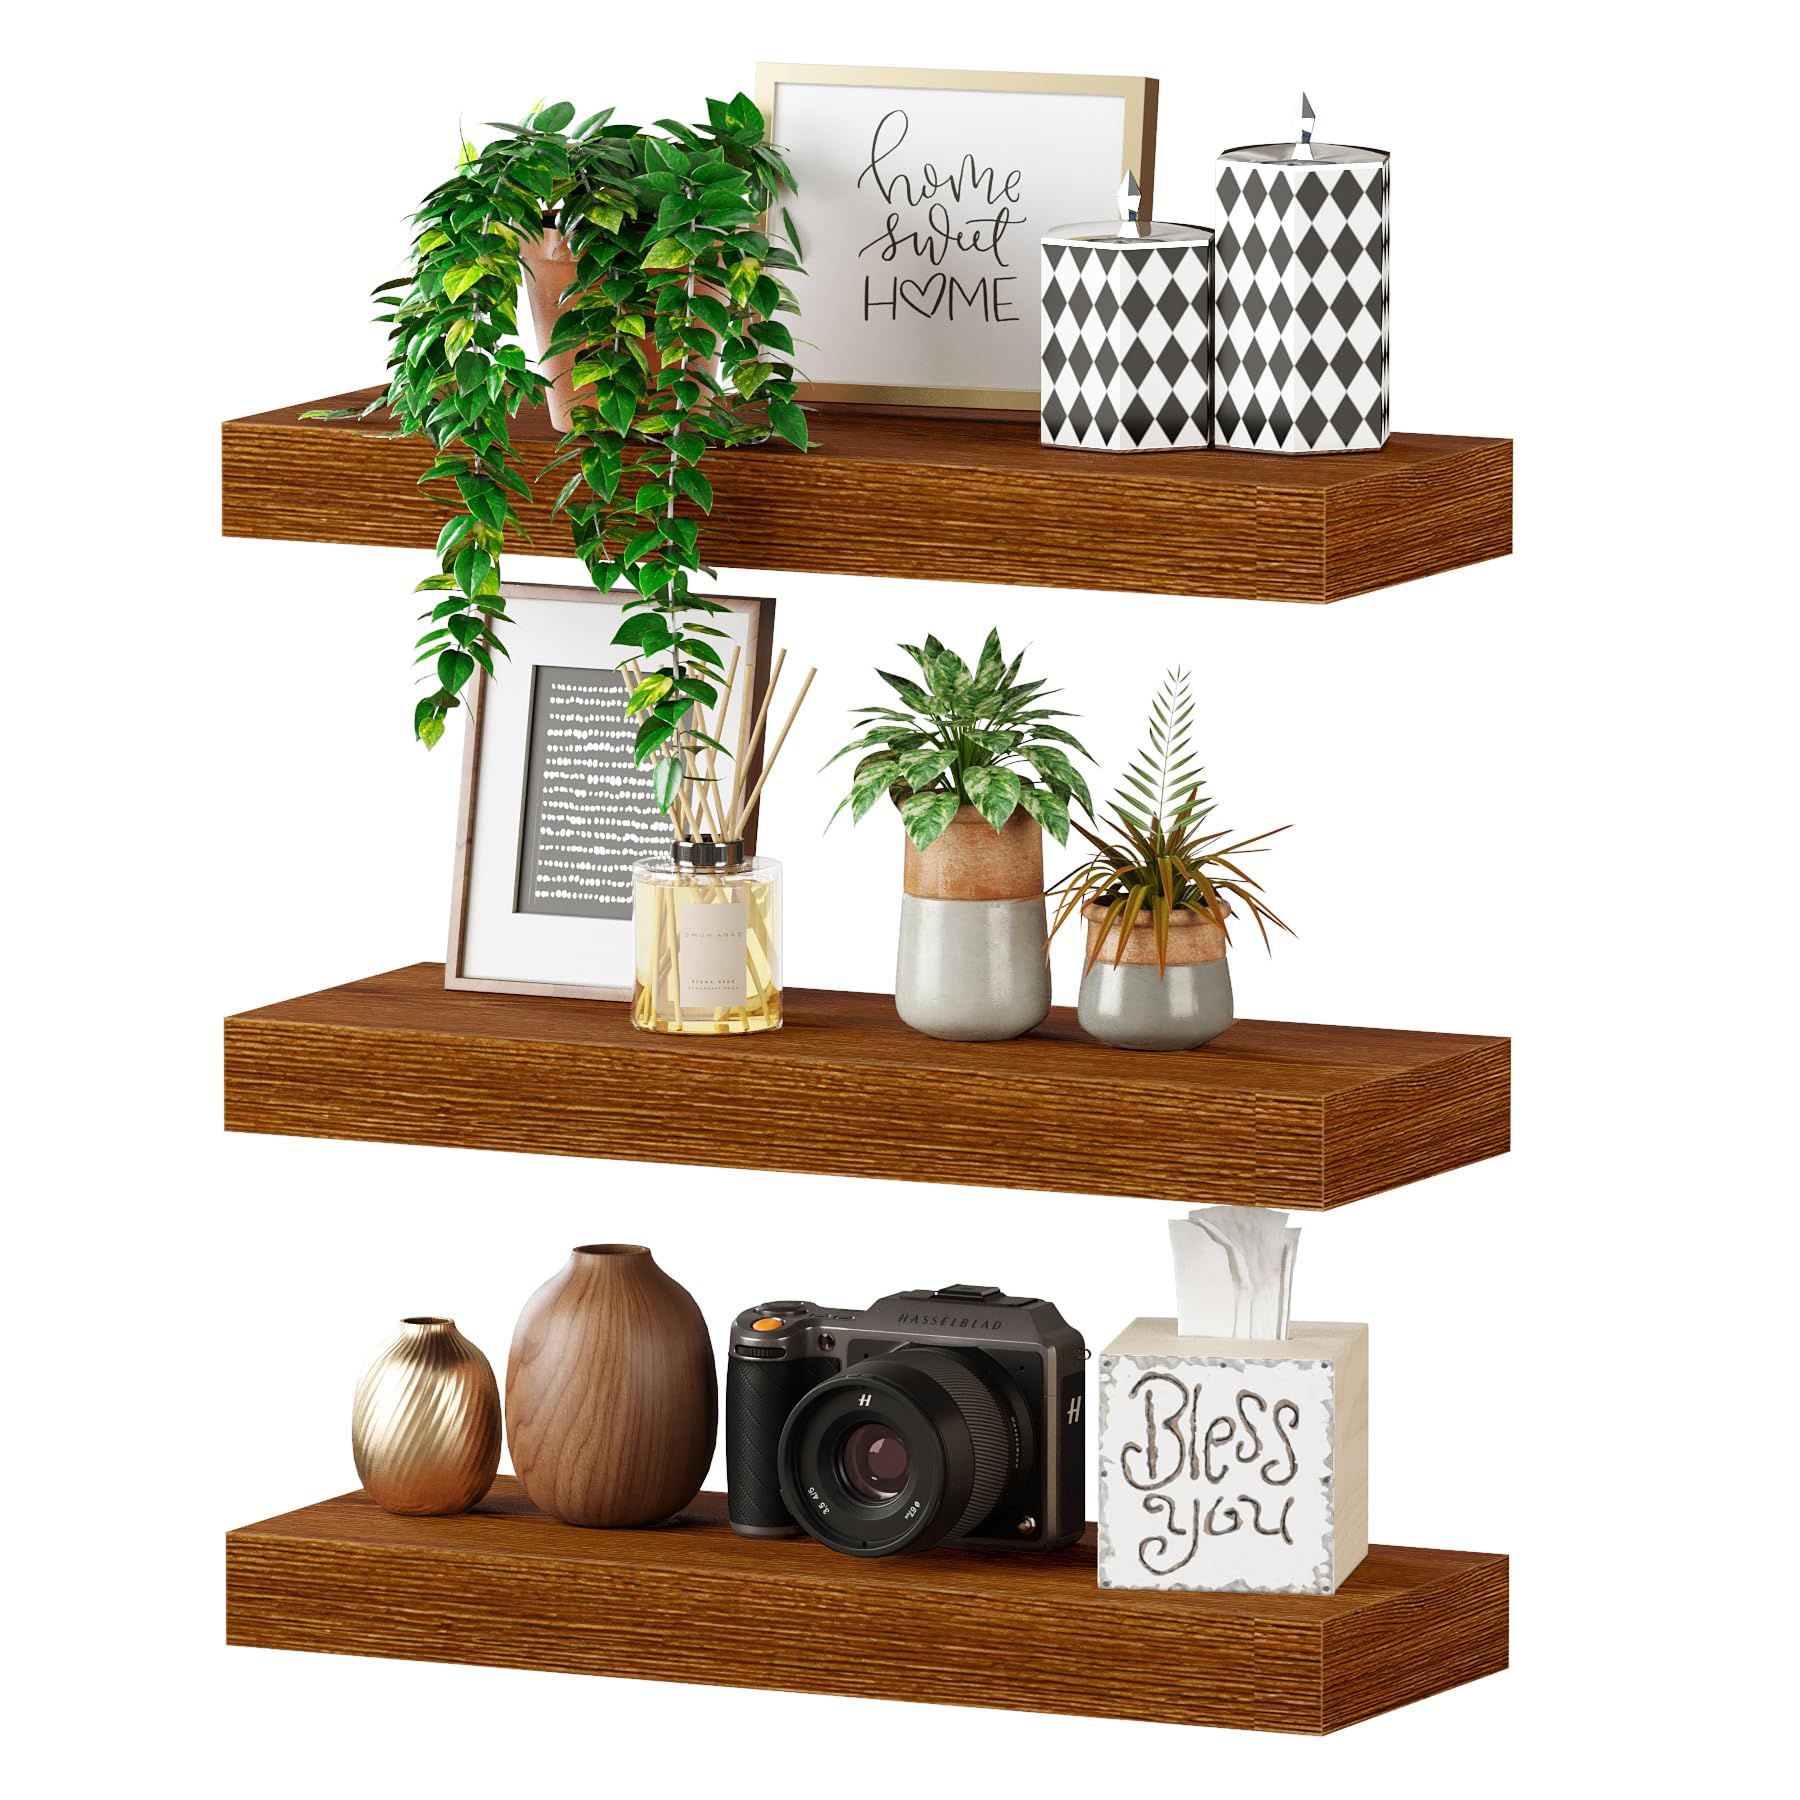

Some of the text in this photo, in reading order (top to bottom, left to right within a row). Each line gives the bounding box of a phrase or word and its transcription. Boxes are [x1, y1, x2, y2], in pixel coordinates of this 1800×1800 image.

[857, 109, 1022, 207] home
[858, 203, 1027, 267] sweet
[898, 1313, 1003, 1330] HASSELBLAD
[858, 1393, 872, 1407] H
[1066, 1395, 1082, 1425] H
[1121, 1371, 1300, 1491] Bless
[1138, 1493, 1295, 1576] you
